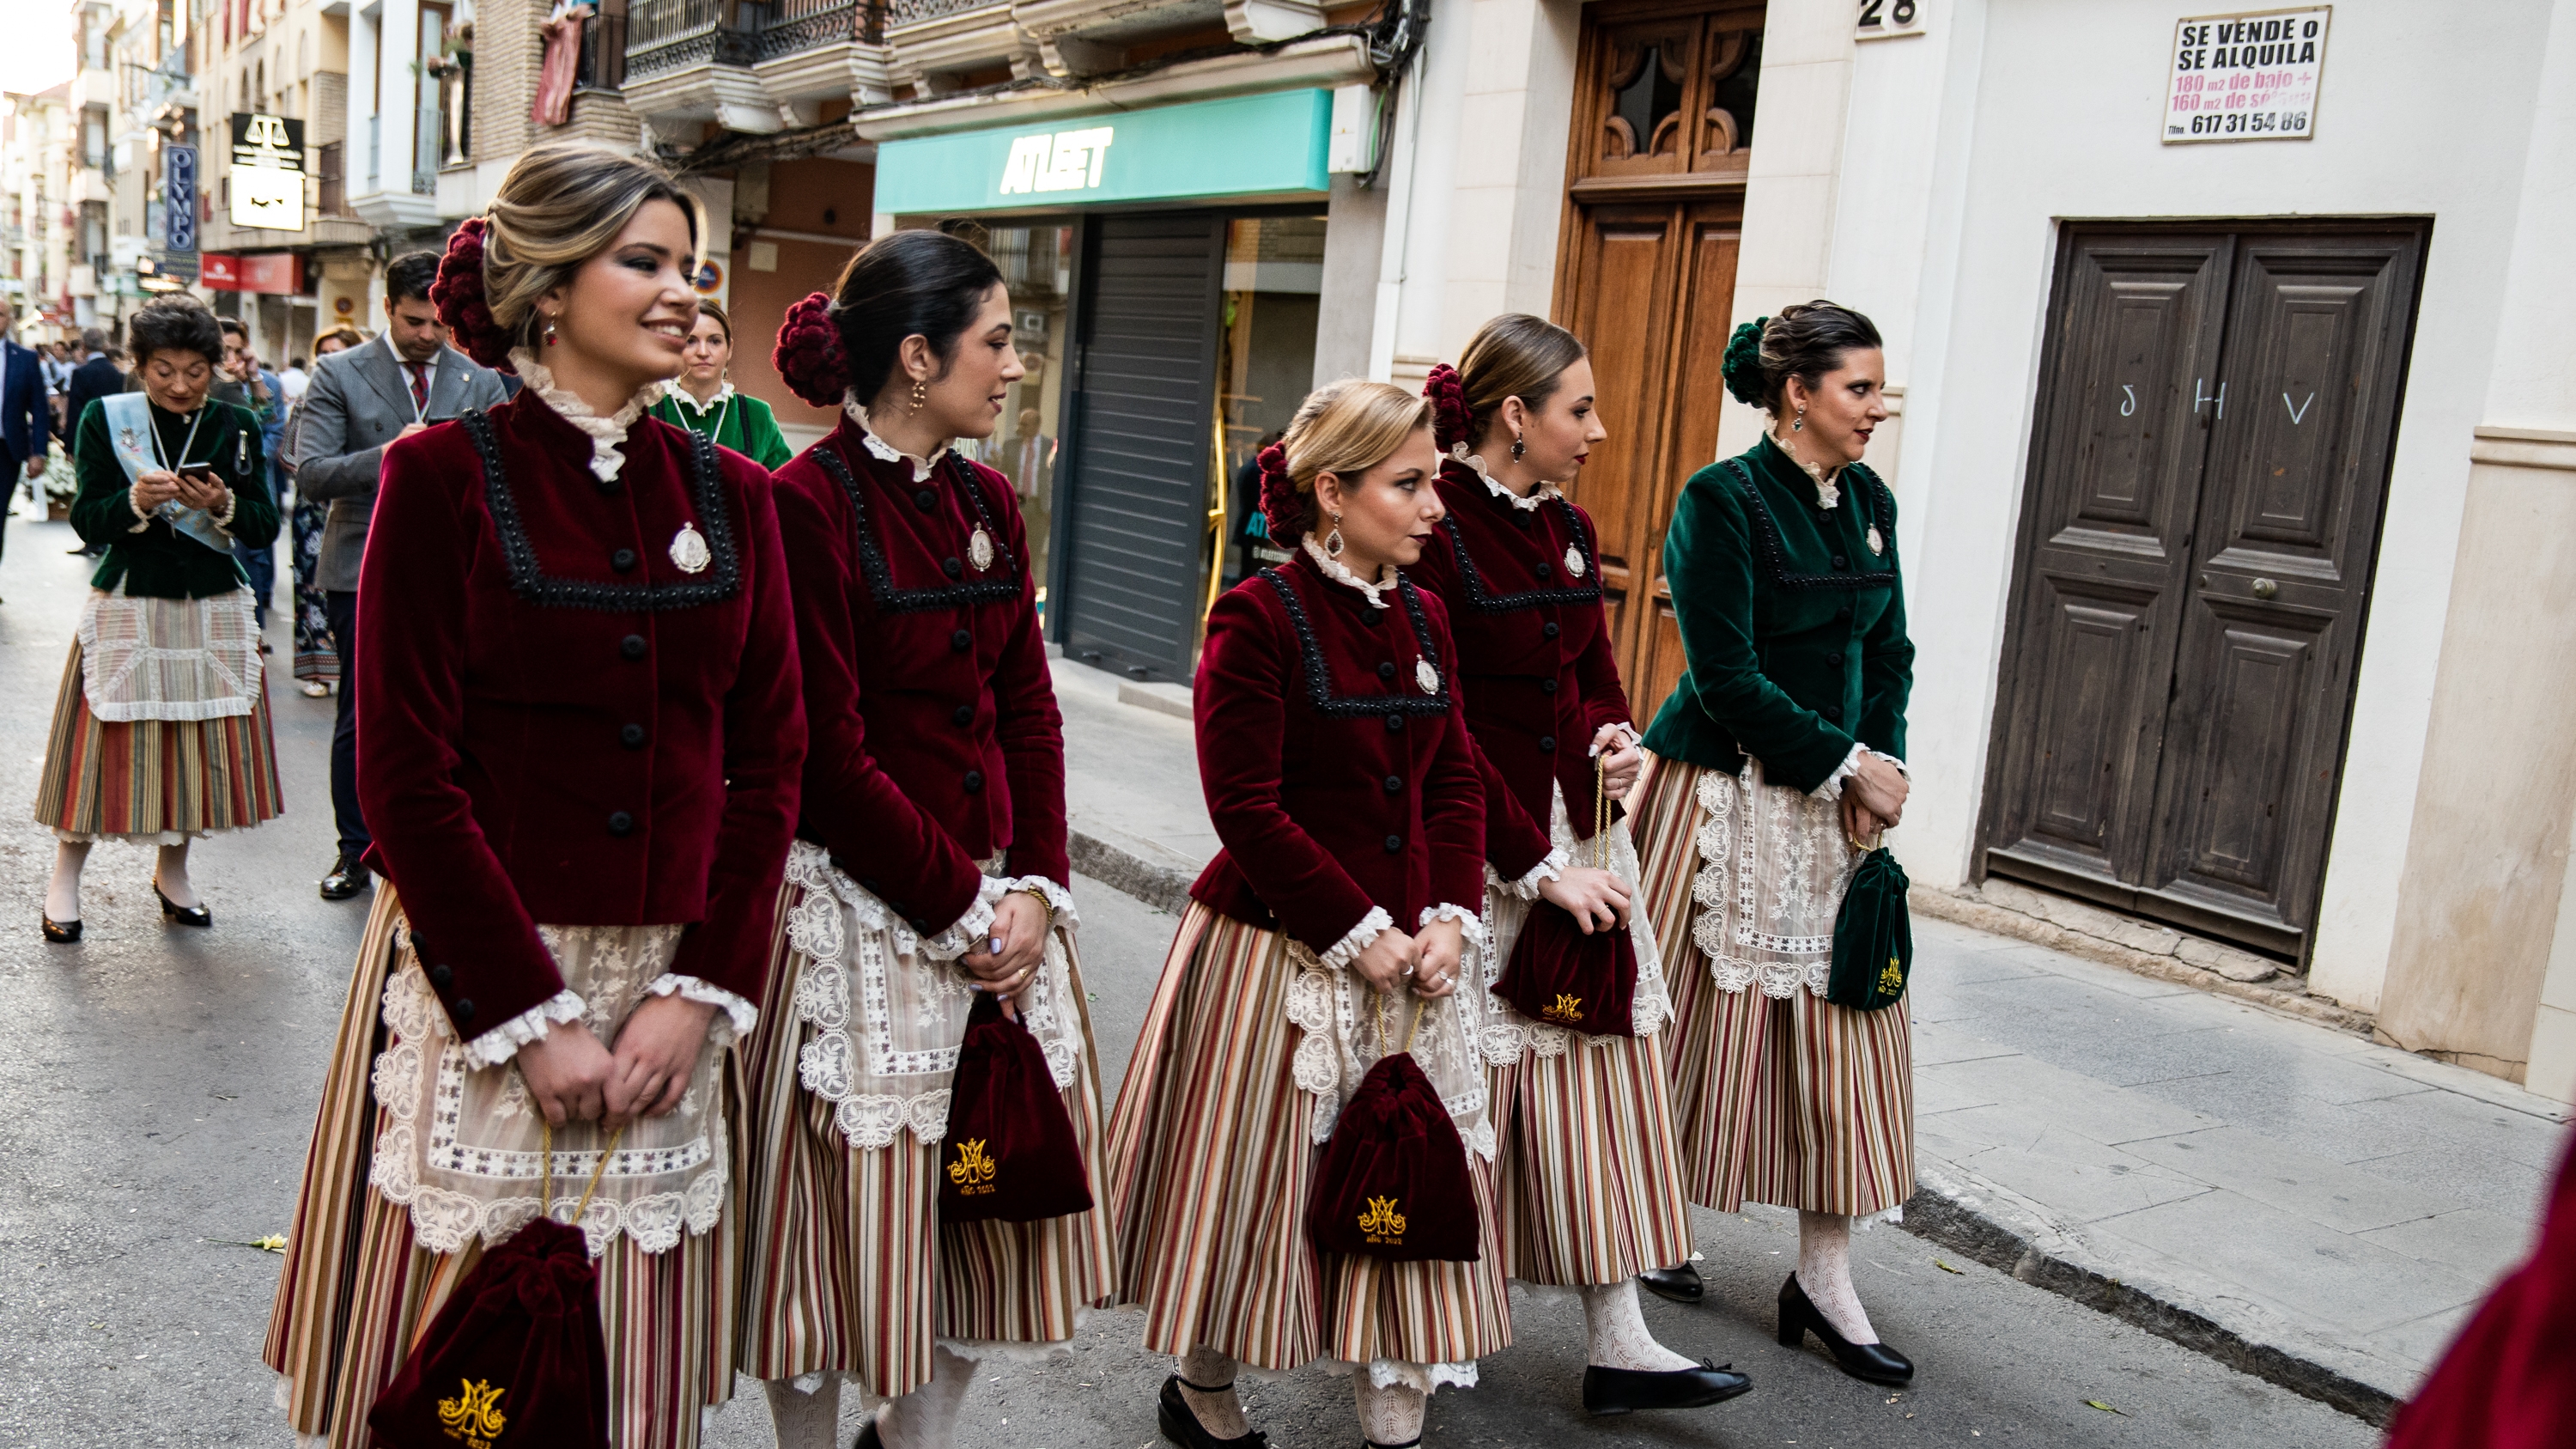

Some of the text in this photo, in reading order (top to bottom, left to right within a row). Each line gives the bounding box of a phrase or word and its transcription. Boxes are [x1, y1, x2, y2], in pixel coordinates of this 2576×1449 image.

[2182, 19, 2318, 47] SE VENDE O
[2178, 41, 2315, 70] SE ALQUILA
[2176, 75, 2204, 93] 180
[2207, 79, 2225, 91] m2
[2228, 73, 2250, 90] de
[2254, 70, 2293, 89] bajo
[2172, 94, 2201, 112] 160
[2203, 98, 2221, 110] m2
[2225, 92, 2246, 109] de
[2191, 114, 2222, 134] 617
[2226, 113, 2247, 132] 31
[2251, 113, 2275, 132] 54
[999, 126, 1114, 195] ATLEET
[2282, 392, 2314, 424] V
